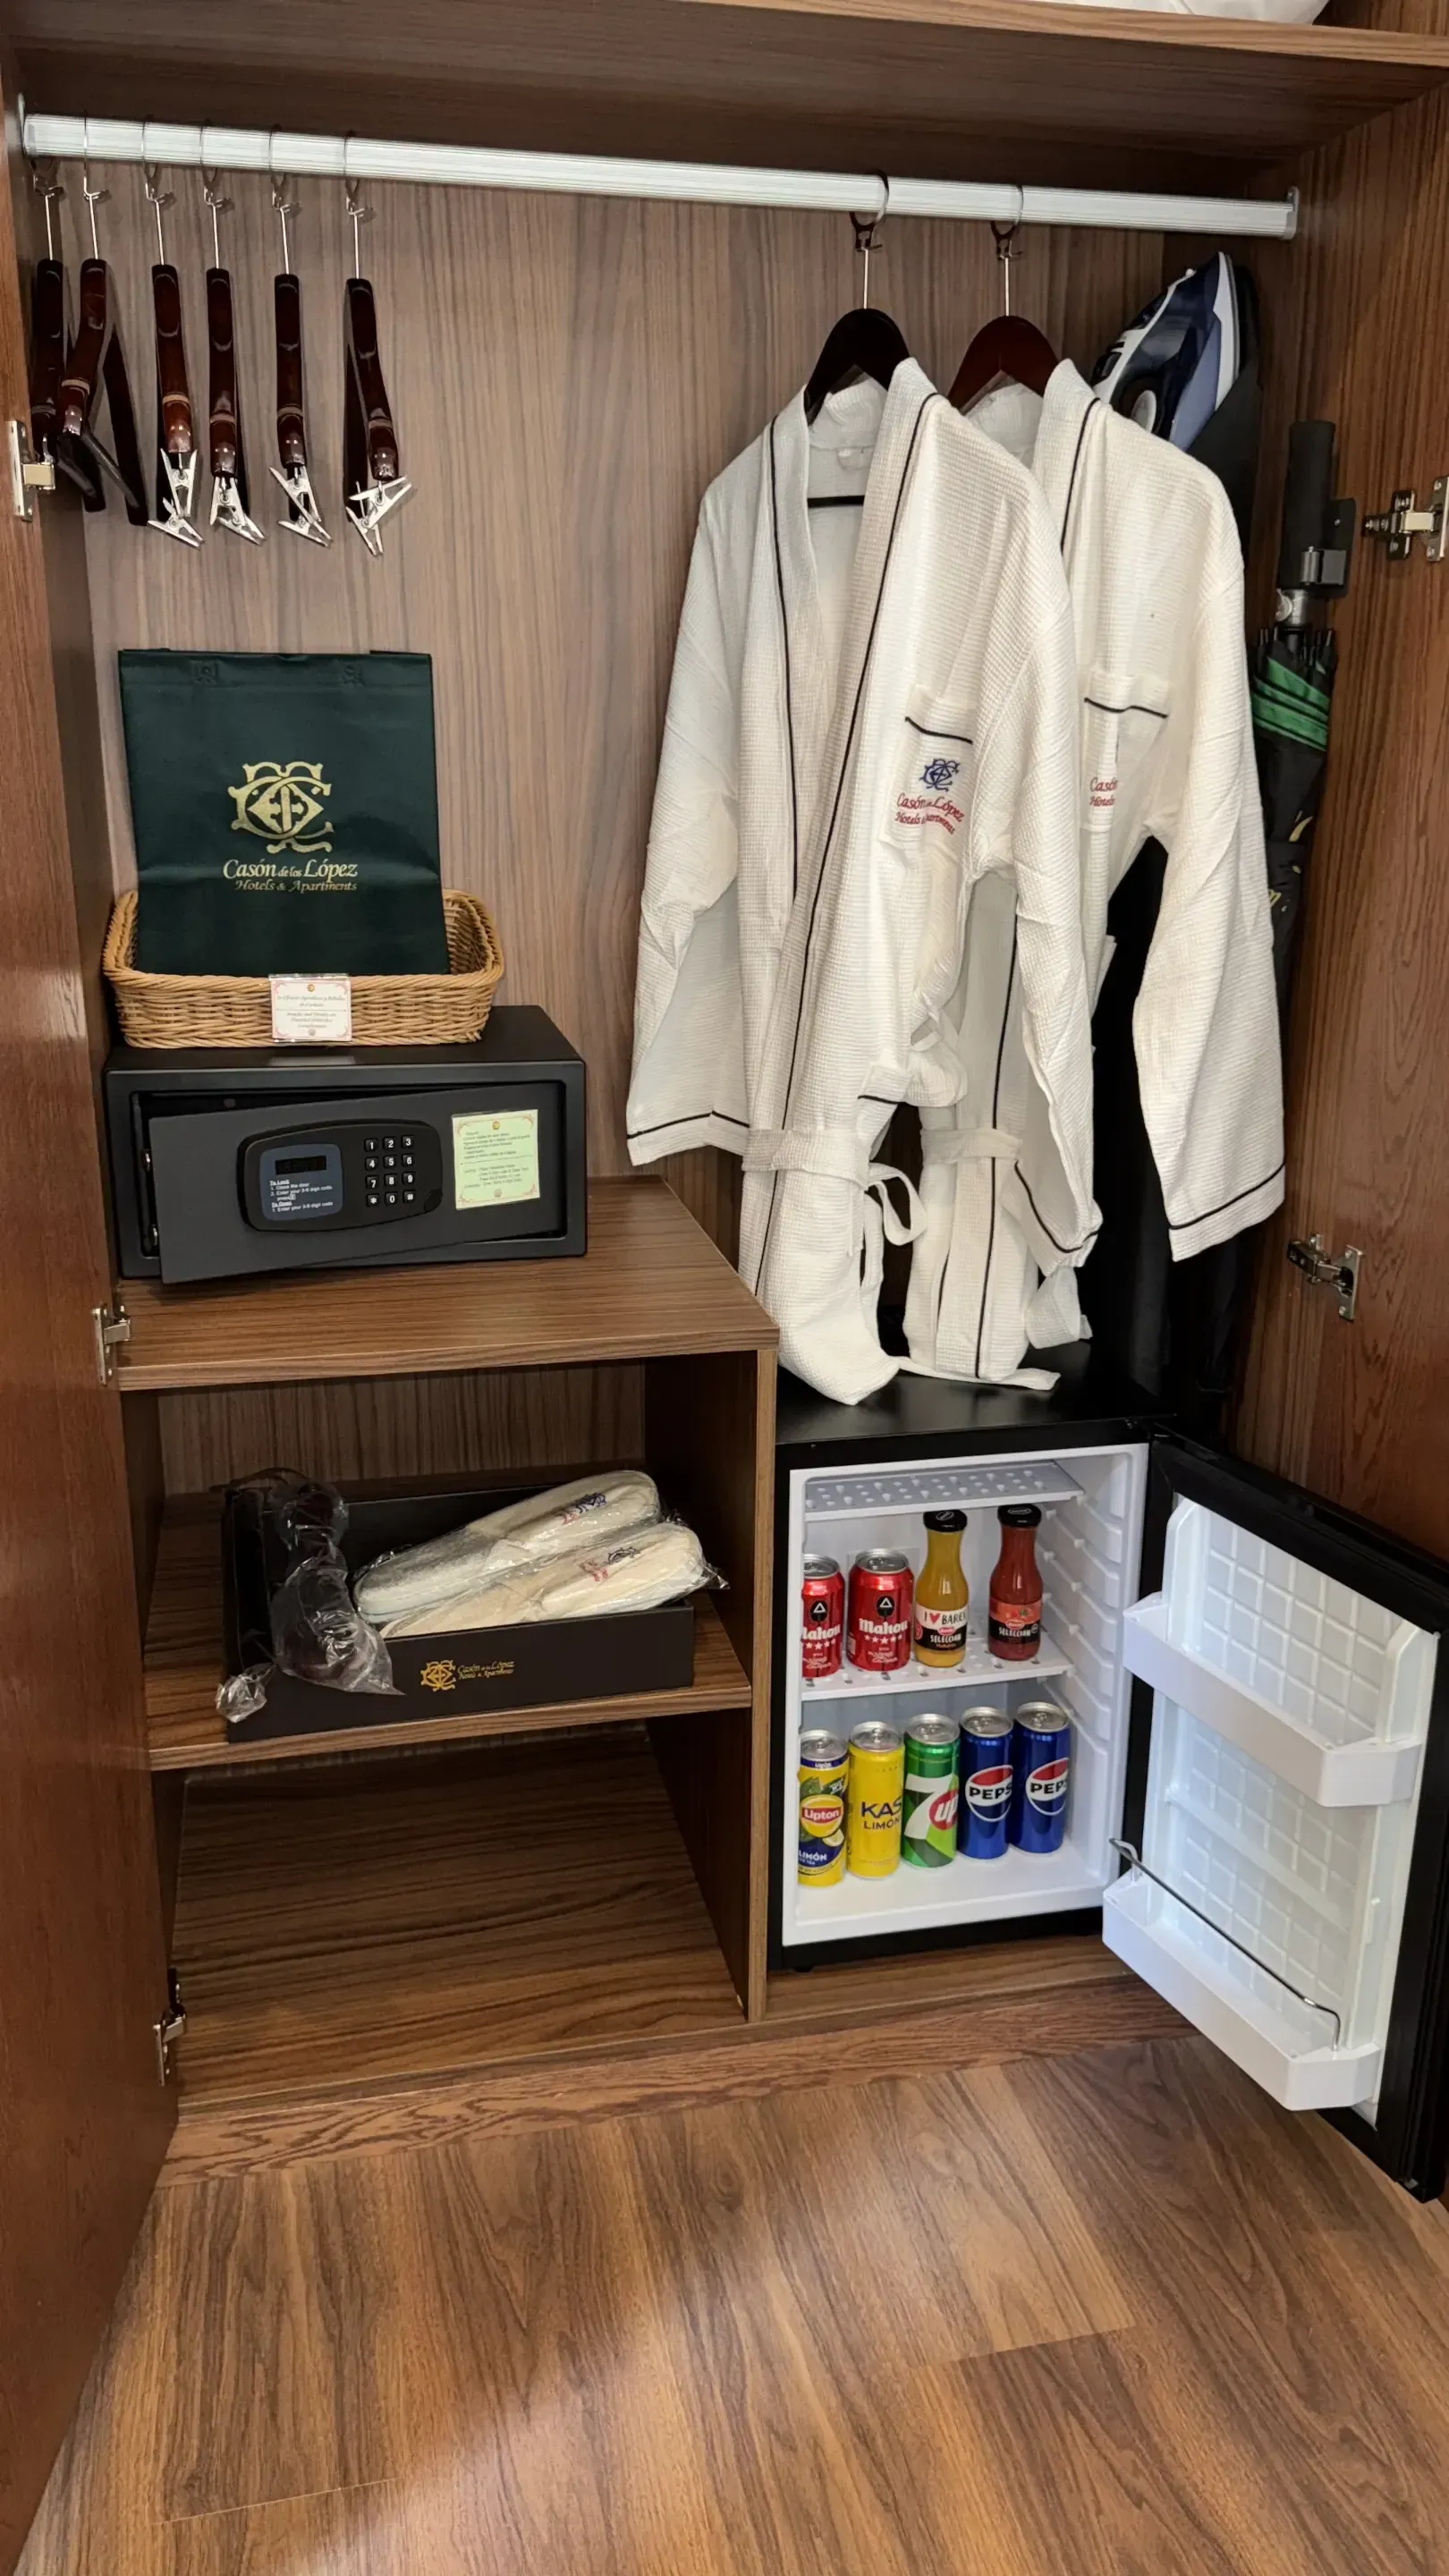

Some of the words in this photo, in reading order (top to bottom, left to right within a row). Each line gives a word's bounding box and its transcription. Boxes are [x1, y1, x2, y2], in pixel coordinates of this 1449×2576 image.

[1090, 776, 1118, 792] Casó
[933, 796, 965, 823] López
[223, 859, 276, 879] Casón
[278, 867, 289, 877] de
[289, 866, 302, 877] los
[303, 859, 359, 883] López
[234, 878, 275, 892] Hotels
[276, 884, 286, 892] &
[288, 880, 358, 894] Apartments
[369, 1141, 374, 1150] 1
[388, 1140, 394, 1148] 2
[405, 1138, 411, 1147] 3
[369, 1159, 376, 1168] 4
[388, 1157, 394, 1166] 5
[406, 1157, 412, 1165] 6
[370, 1179, 377, 1189] 7
[388, 1176, 394, 1185] 8
[407, 1174, 413, 1183] 9
[389, 1195, 395, 1204] 0
[859, 1618, 908, 1635] Mahou
[969, 1784, 1013, 1801] PEPS
[1030, 1780, 1066, 1794] PEP
[860, 1795, 902, 1819] KAS
[805, 1809, 840, 1821] Lipton
[863, 1818, 901, 1830] LIMÓN
